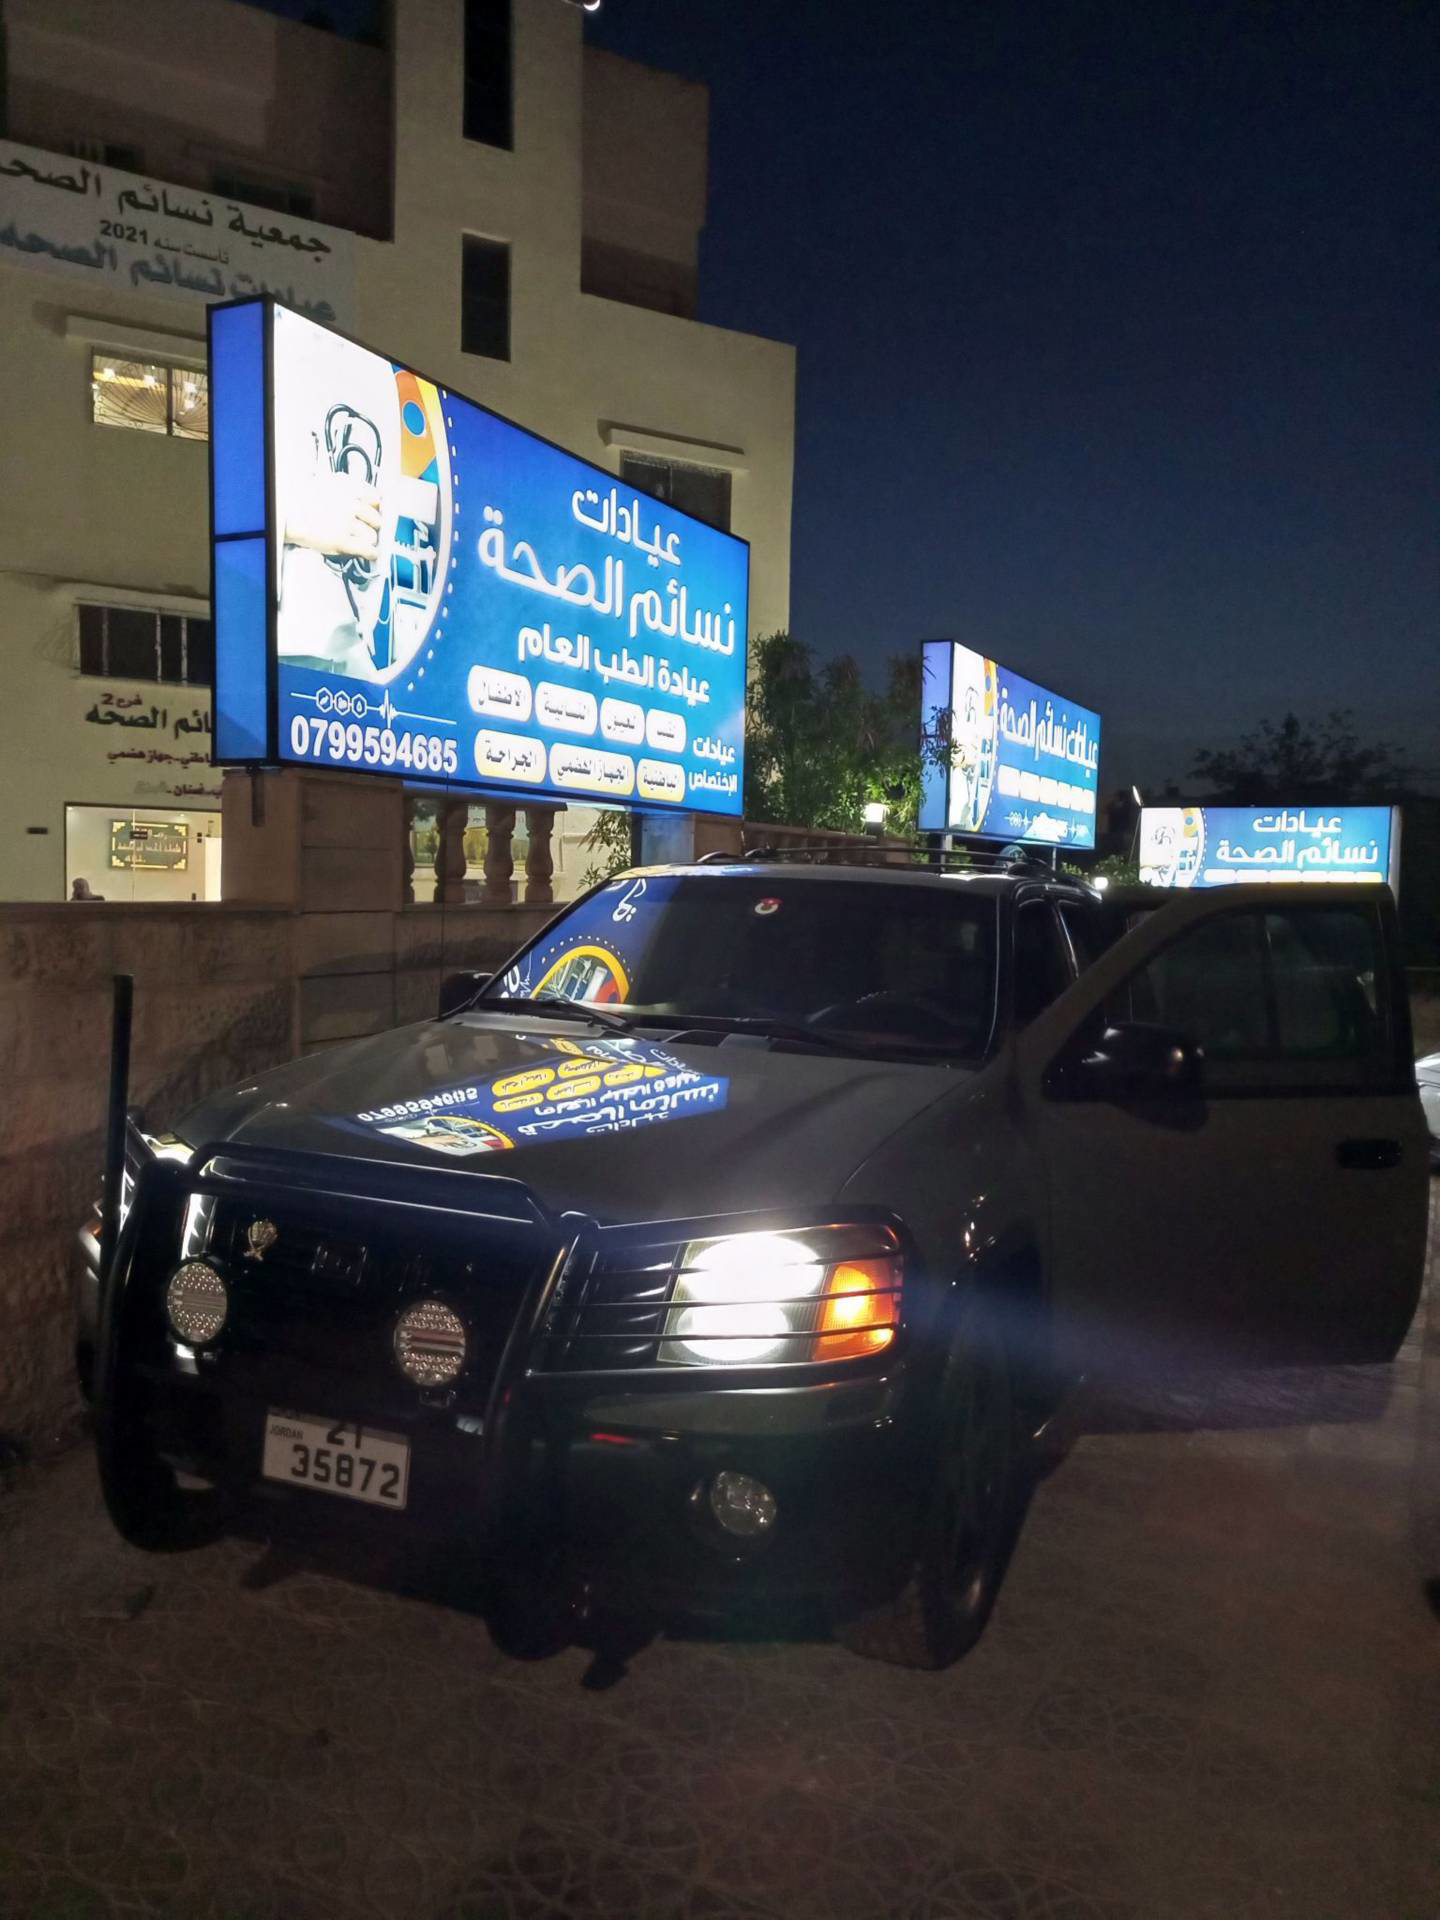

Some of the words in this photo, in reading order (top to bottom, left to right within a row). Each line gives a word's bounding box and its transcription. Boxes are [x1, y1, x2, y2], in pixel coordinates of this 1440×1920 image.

[0, 157, 101, 197] الصح
[118, 186, 214, 228] نسائم
[100, 219, 148, 246] 2021
[225, 205, 331, 263] جمعية
[571, 488, 682, 567] عيادات
[477, 505, 624, 618] الصحة
[629, 577, 735, 656] نسائم
[517, 623, 591, 671] العام
[593, 648, 656, 690] الطب
[657, 658, 711, 707] عيادة
[101, 693, 115, 706] 2
[173, 709, 212, 739] ائم
[290, 714, 458, 773] 0799594685
[1034, 700, 1068, 762] نسائم
[692, 736, 737, 766] عيادات
[1252, 810, 1343, 838] عيادات
[1215, 838, 1295, 864] الصحة
[1297, 837, 1379, 868] نسائم
[290, 1443, 401, 1500] 35872
